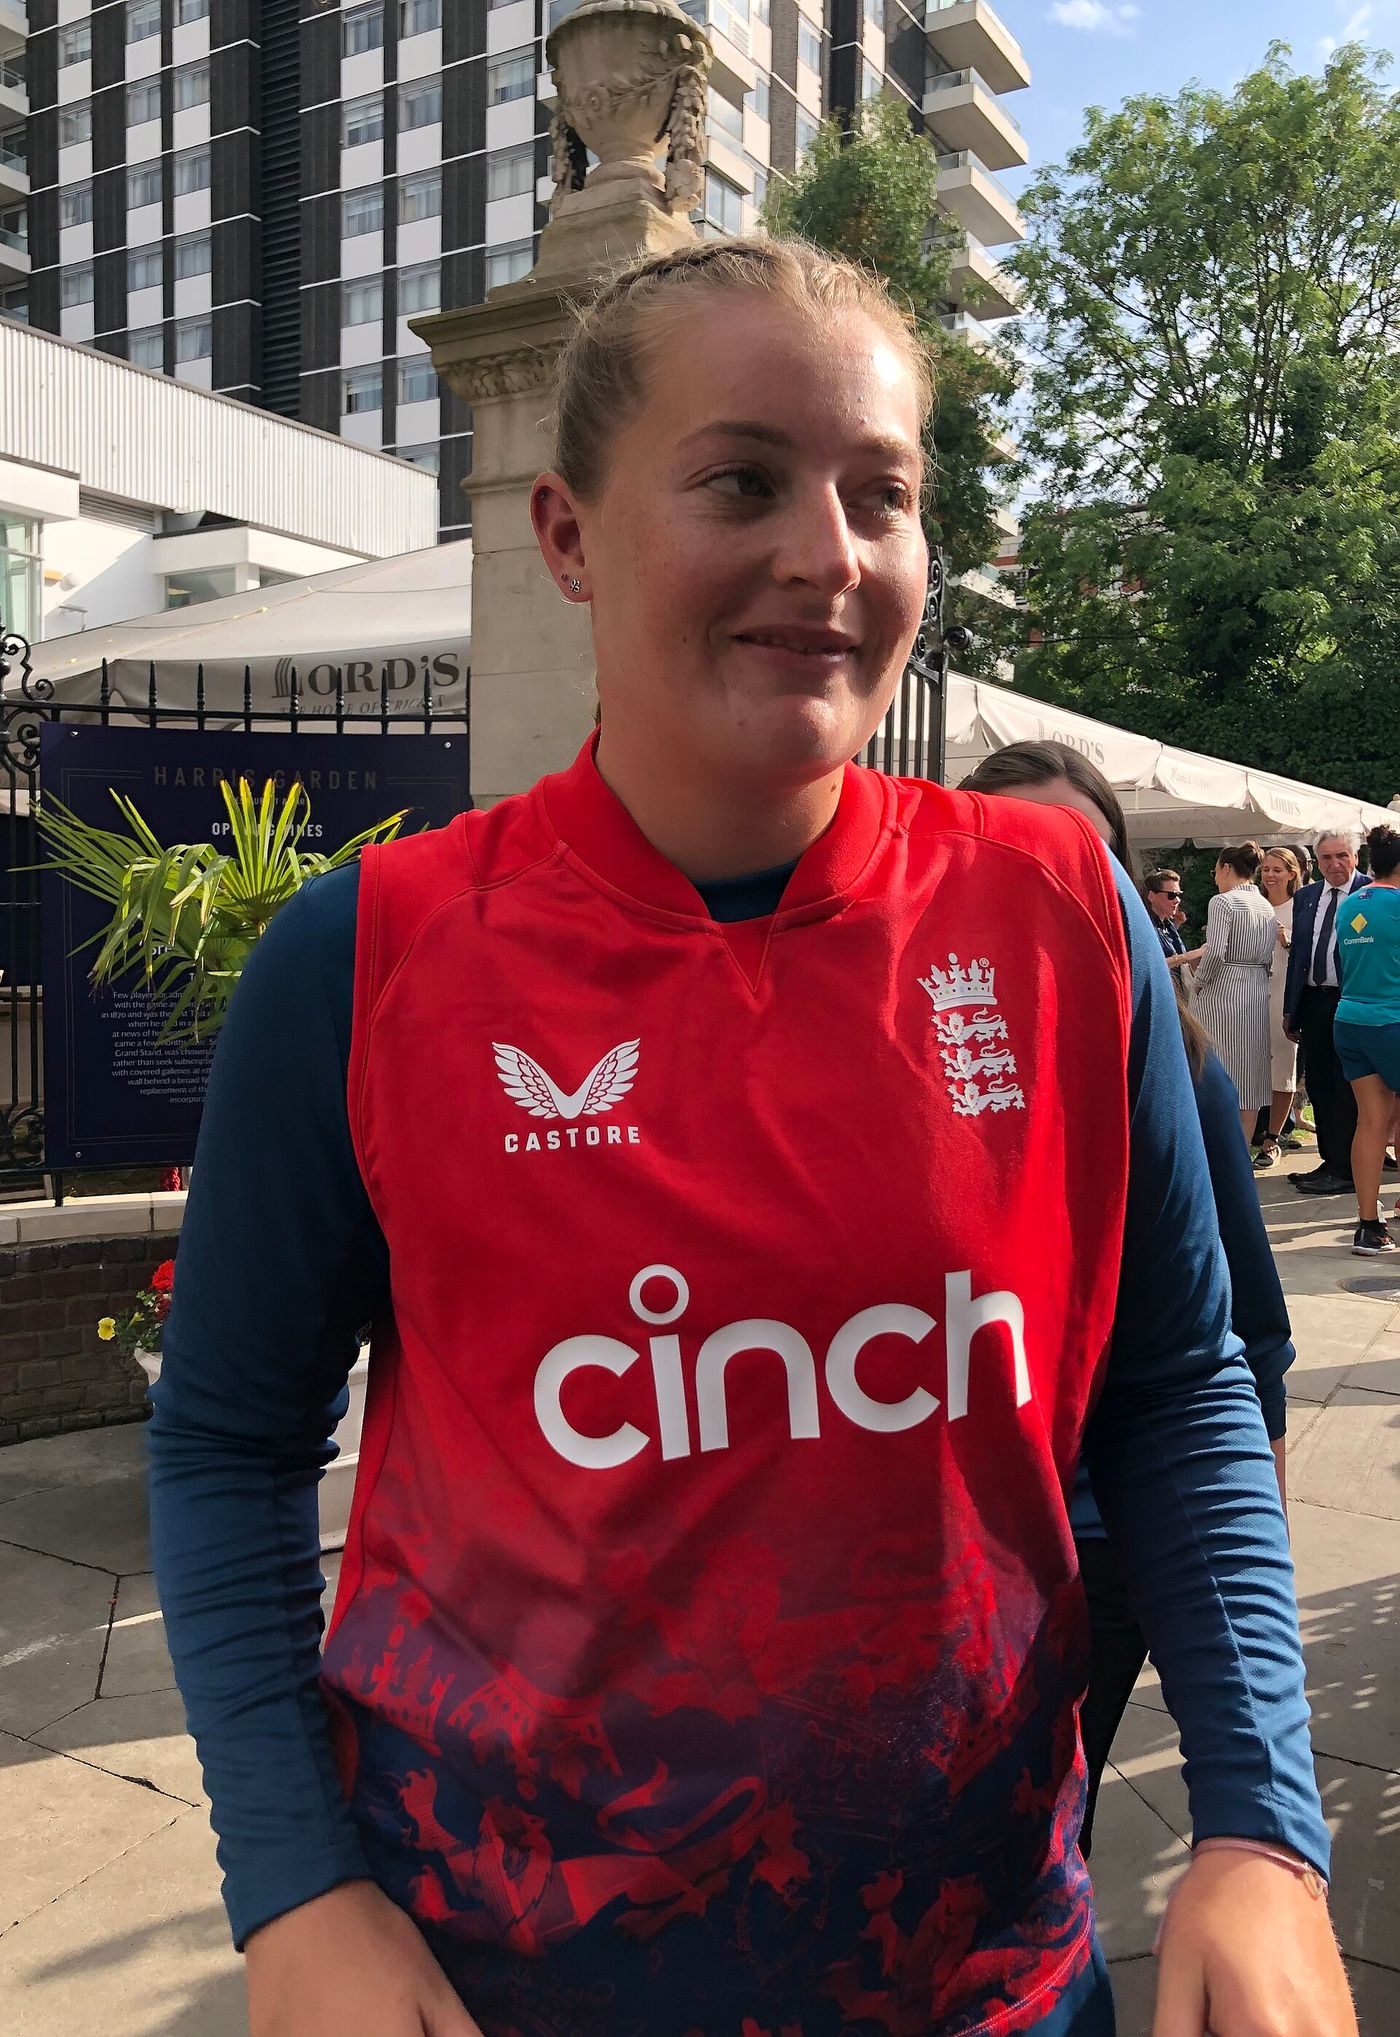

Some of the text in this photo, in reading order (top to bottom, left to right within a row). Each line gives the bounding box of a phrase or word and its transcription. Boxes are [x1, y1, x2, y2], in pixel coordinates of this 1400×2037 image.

[360, 701, 379, 714] OF
[1343, 936, 1375, 946] CommBank
[113, 991, 128, 999] Few
[114, 1000, 131, 1009] with
[133, 1000, 145, 1008] the
[101, 1011, 109, 1019] in
[128, 1010, 142, 1018] and
[127, 1019, 148, 1028] when
[150, 1018, 160, 1026] he
[115, 1040, 135, 1048] came
[115, 1049, 139, 1057] Grand
[164, 1049, 179, 1057] was
[113, 1058, 135, 1067] rather
[137, 1057, 154, 1066] than
[112, 1068, 128, 1077] with
[129, 1066, 160, 1075] covered
[504, 1125, 641, 1153] CASTORE
[533, 1263, 1032, 1470] cinch
